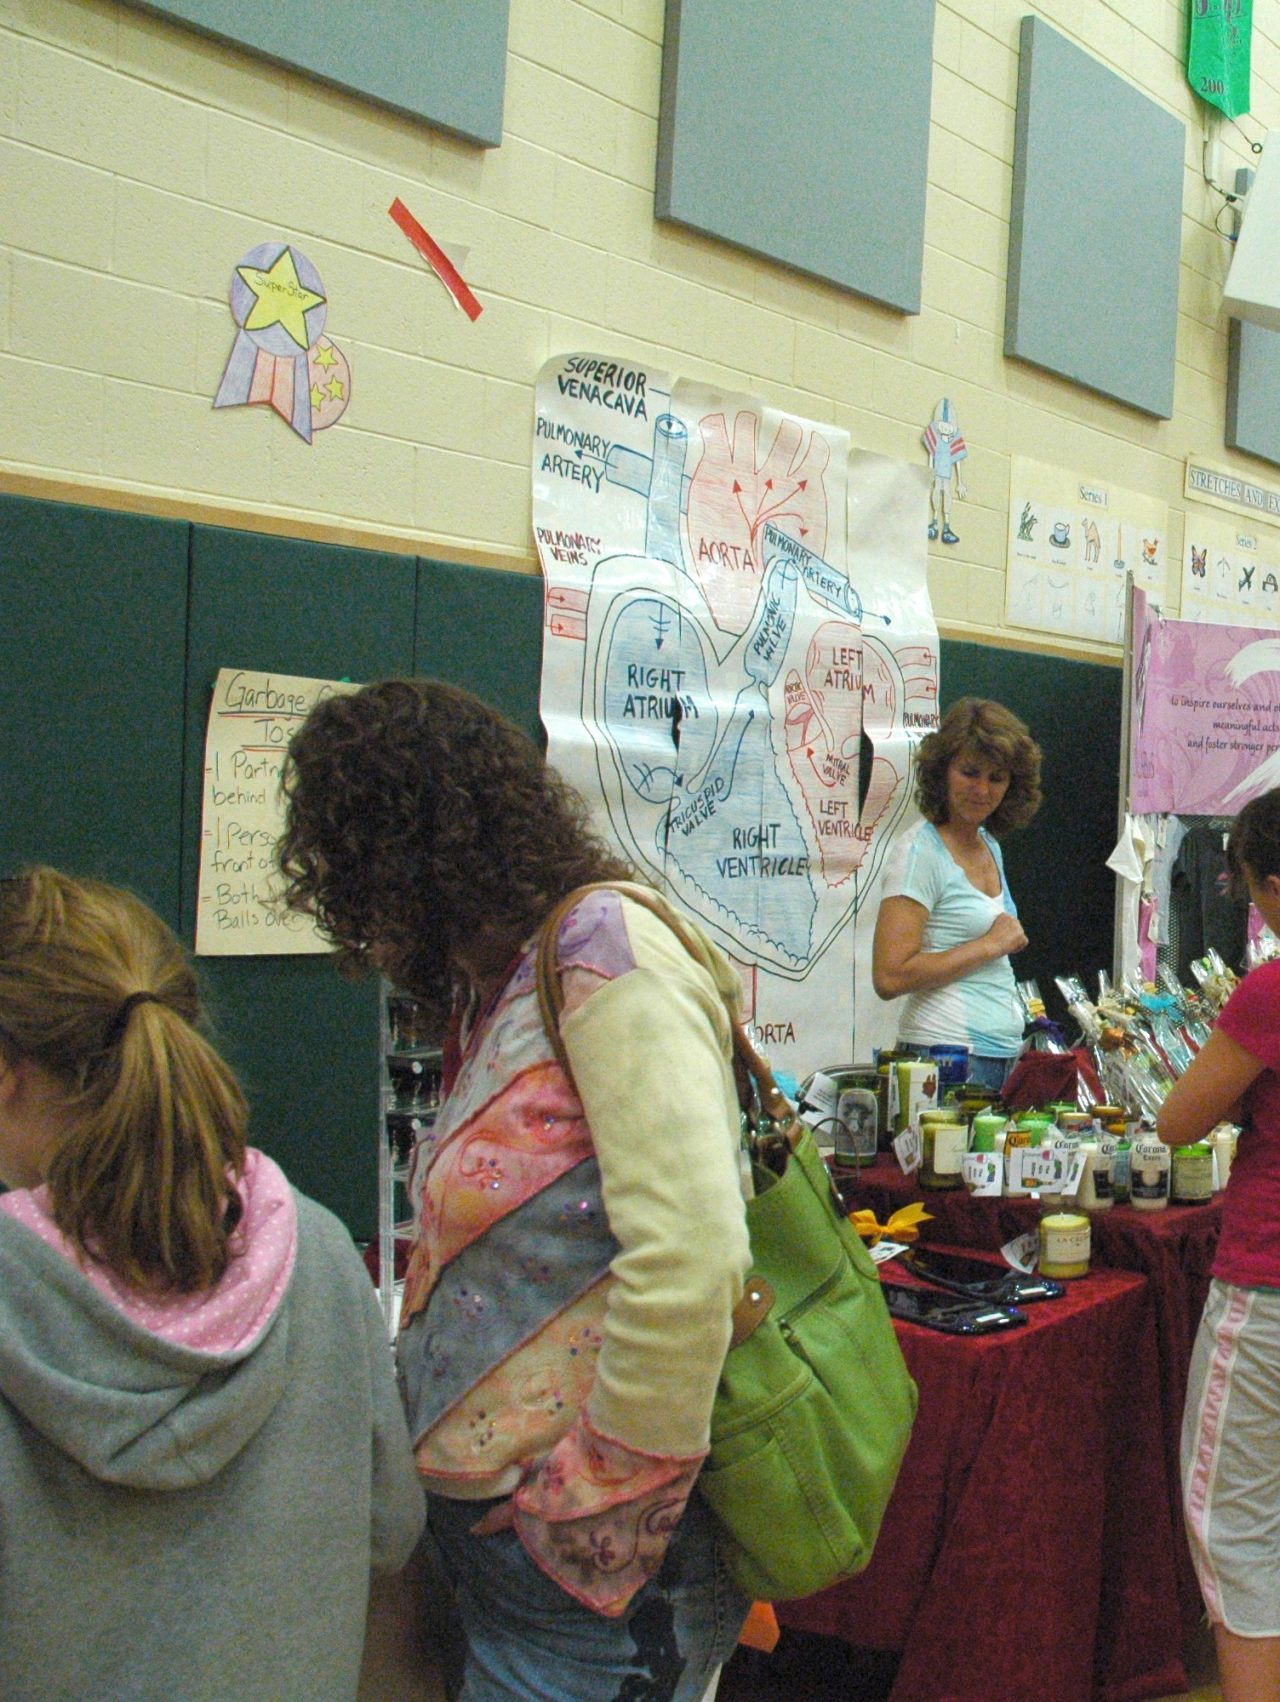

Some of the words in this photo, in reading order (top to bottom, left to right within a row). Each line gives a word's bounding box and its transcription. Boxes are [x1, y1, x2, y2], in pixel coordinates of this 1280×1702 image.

[564, 357, 647, 398] SUPERIOR
[536, 416, 611, 459] PULMONARY
[541, 453, 605, 493] ARTERY
[1079, 486, 1102, 504] Series
[1190, 469, 1241, 497] STRETCHES
[1246, 487, 1263, 506] AND
[537, 527, 601, 555] PULMONARY
[550, 547, 588, 566] VEINS
[699, 537, 756, 574] AORTA
[764, 526, 813, 566] PULMONARY
[803, 566, 842, 597] ARTERY
[753, 592, 781, 656] PULMONIC
[763, 614, 787, 662] VALVE
[832, 648, 863, 670] LEFT
[628, 663, 686, 692] RIGHT
[824, 670, 875, 704] ATRIUM
[225, 672, 308, 721] Garbage
[623, 694, 699, 719] ATRIUM
[1180, 696, 1211, 713] inspire
[1212, 698, 1251, 710] ourselves
[1253, 702, 1272, 713] and
[254, 718, 295, 743] Tos
[1212, 719, 1261, 736] meaningful
[1262, 722, 1280, 733] acts
[1187, 738, 1203, 749] and
[1205, 738, 1228, 752] foster
[1230, 740, 1264, 756] stronger
[231, 751, 282, 780] Partn
[823, 763, 847, 786] VALVE
[826, 753, 850, 775] MITRAL
[213, 785, 266, 806] behind
[667, 777, 725, 833] TRICUSPID
[681, 803, 717, 837] VALVE
[820, 800, 849, 819] LEFT
[227, 822, 277, 849] Perso
[733, 823, 781, 850] RIGHT
[818, 820, 874, 841] VENTRICLE
[211, 850, 253, 873] front
[716, 856, 808, 879] VENTRICLE
[216, 882, 260, 905] Both
[213, 909, 259, 930] Balls
[754, 1021, 796, 1045] ORTA
[1135, 1144, 1167, 1154] Corona
